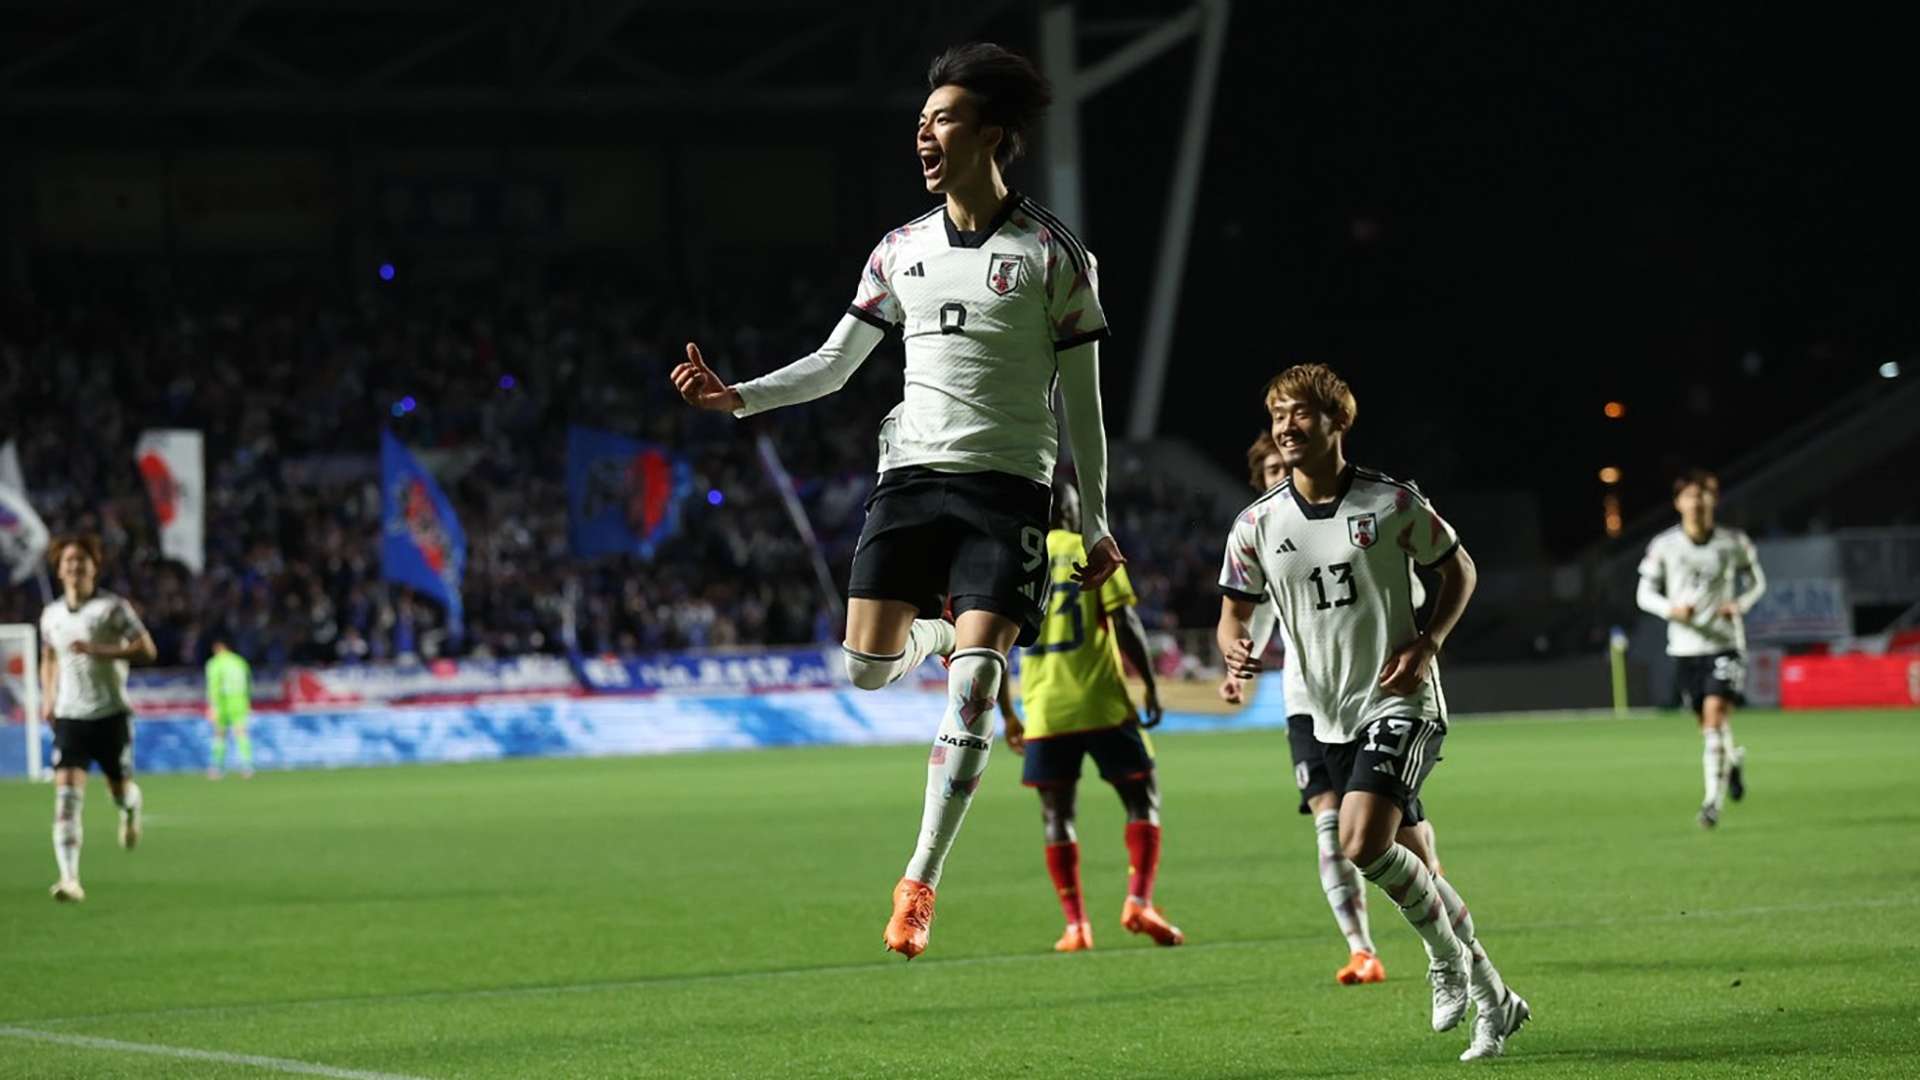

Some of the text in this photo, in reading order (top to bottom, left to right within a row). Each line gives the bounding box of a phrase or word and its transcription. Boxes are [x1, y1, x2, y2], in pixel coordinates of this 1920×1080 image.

[1021, 526, 1044, 573] 9
[1309, 561, 1358, 611] 13
[1024, 582, 1086, 657] 3
[939, 734, 990, 751] JAPAN
[1364, 719, 1413, 757] 13
